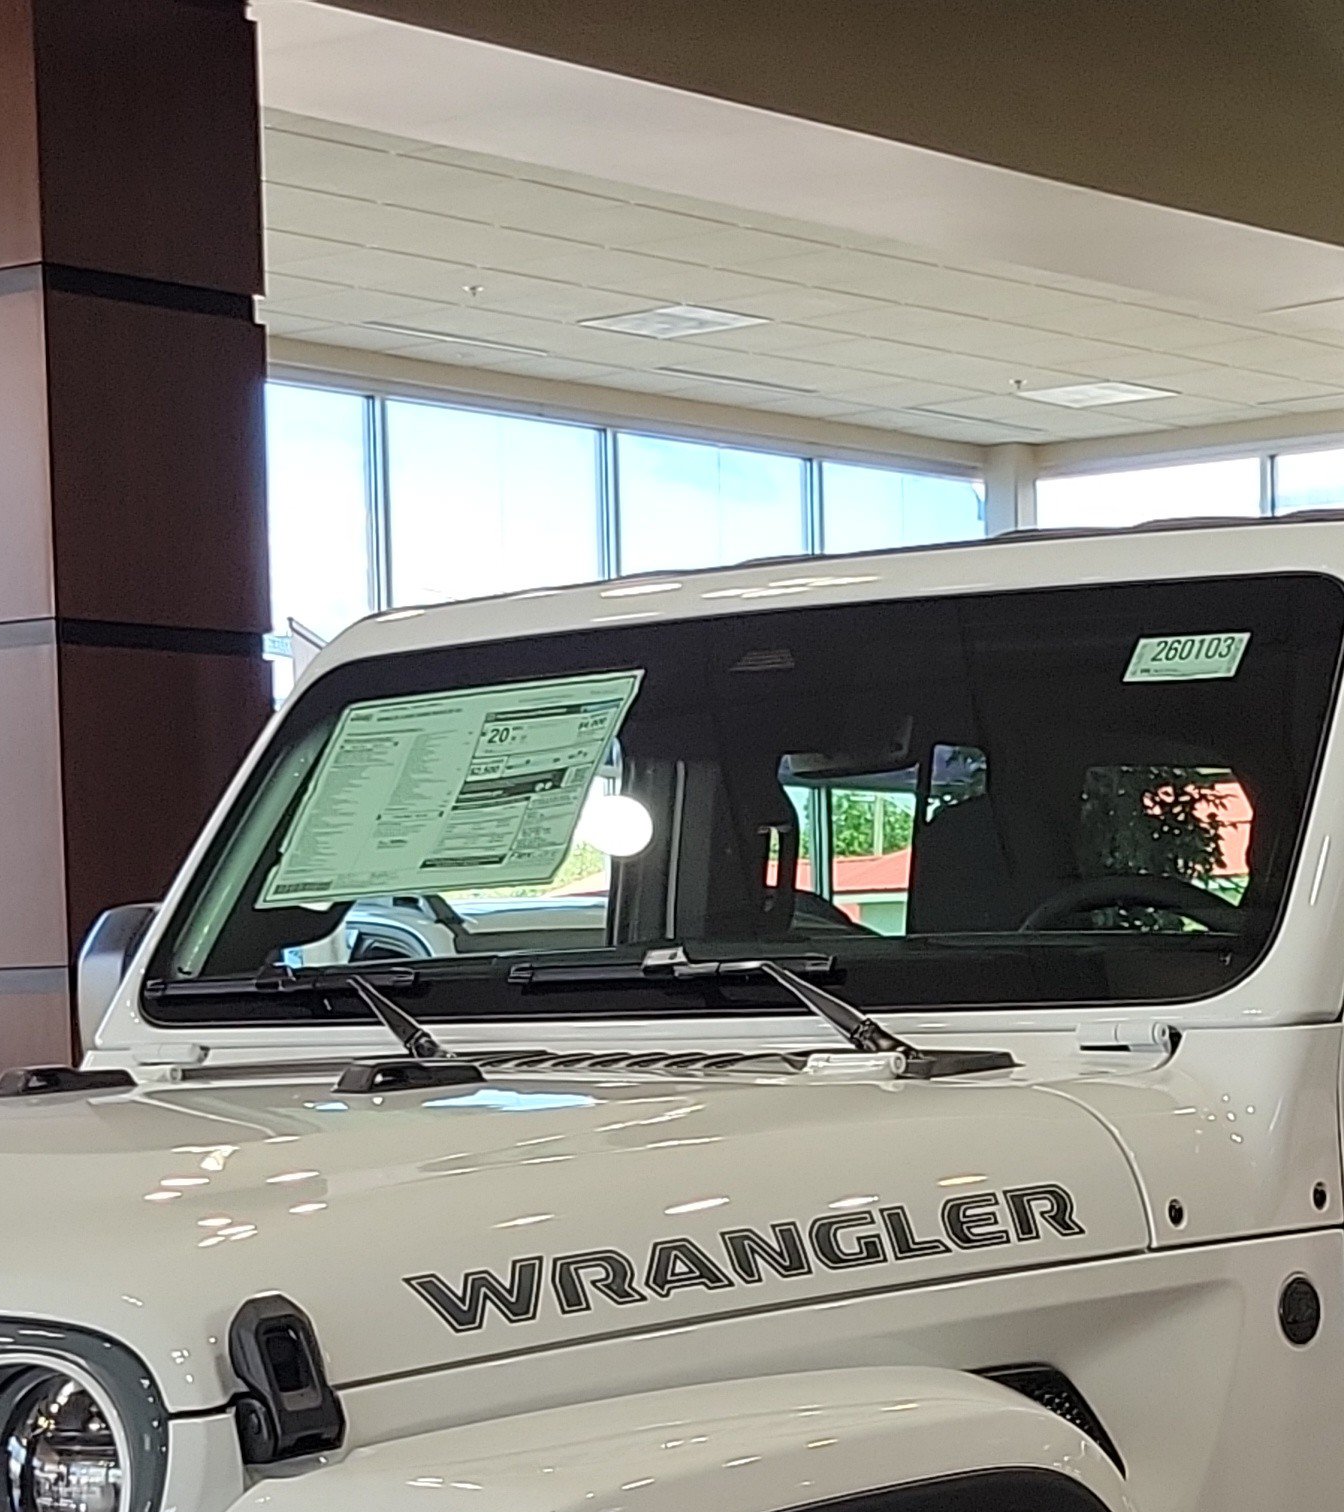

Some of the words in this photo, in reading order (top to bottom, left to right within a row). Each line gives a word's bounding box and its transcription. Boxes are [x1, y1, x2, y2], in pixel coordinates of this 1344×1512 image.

[1150, 636, 1236, 662] 260103
[487, 727, 511, 744] 20
[404, 1182, 1086, 1335] WRANGLER
